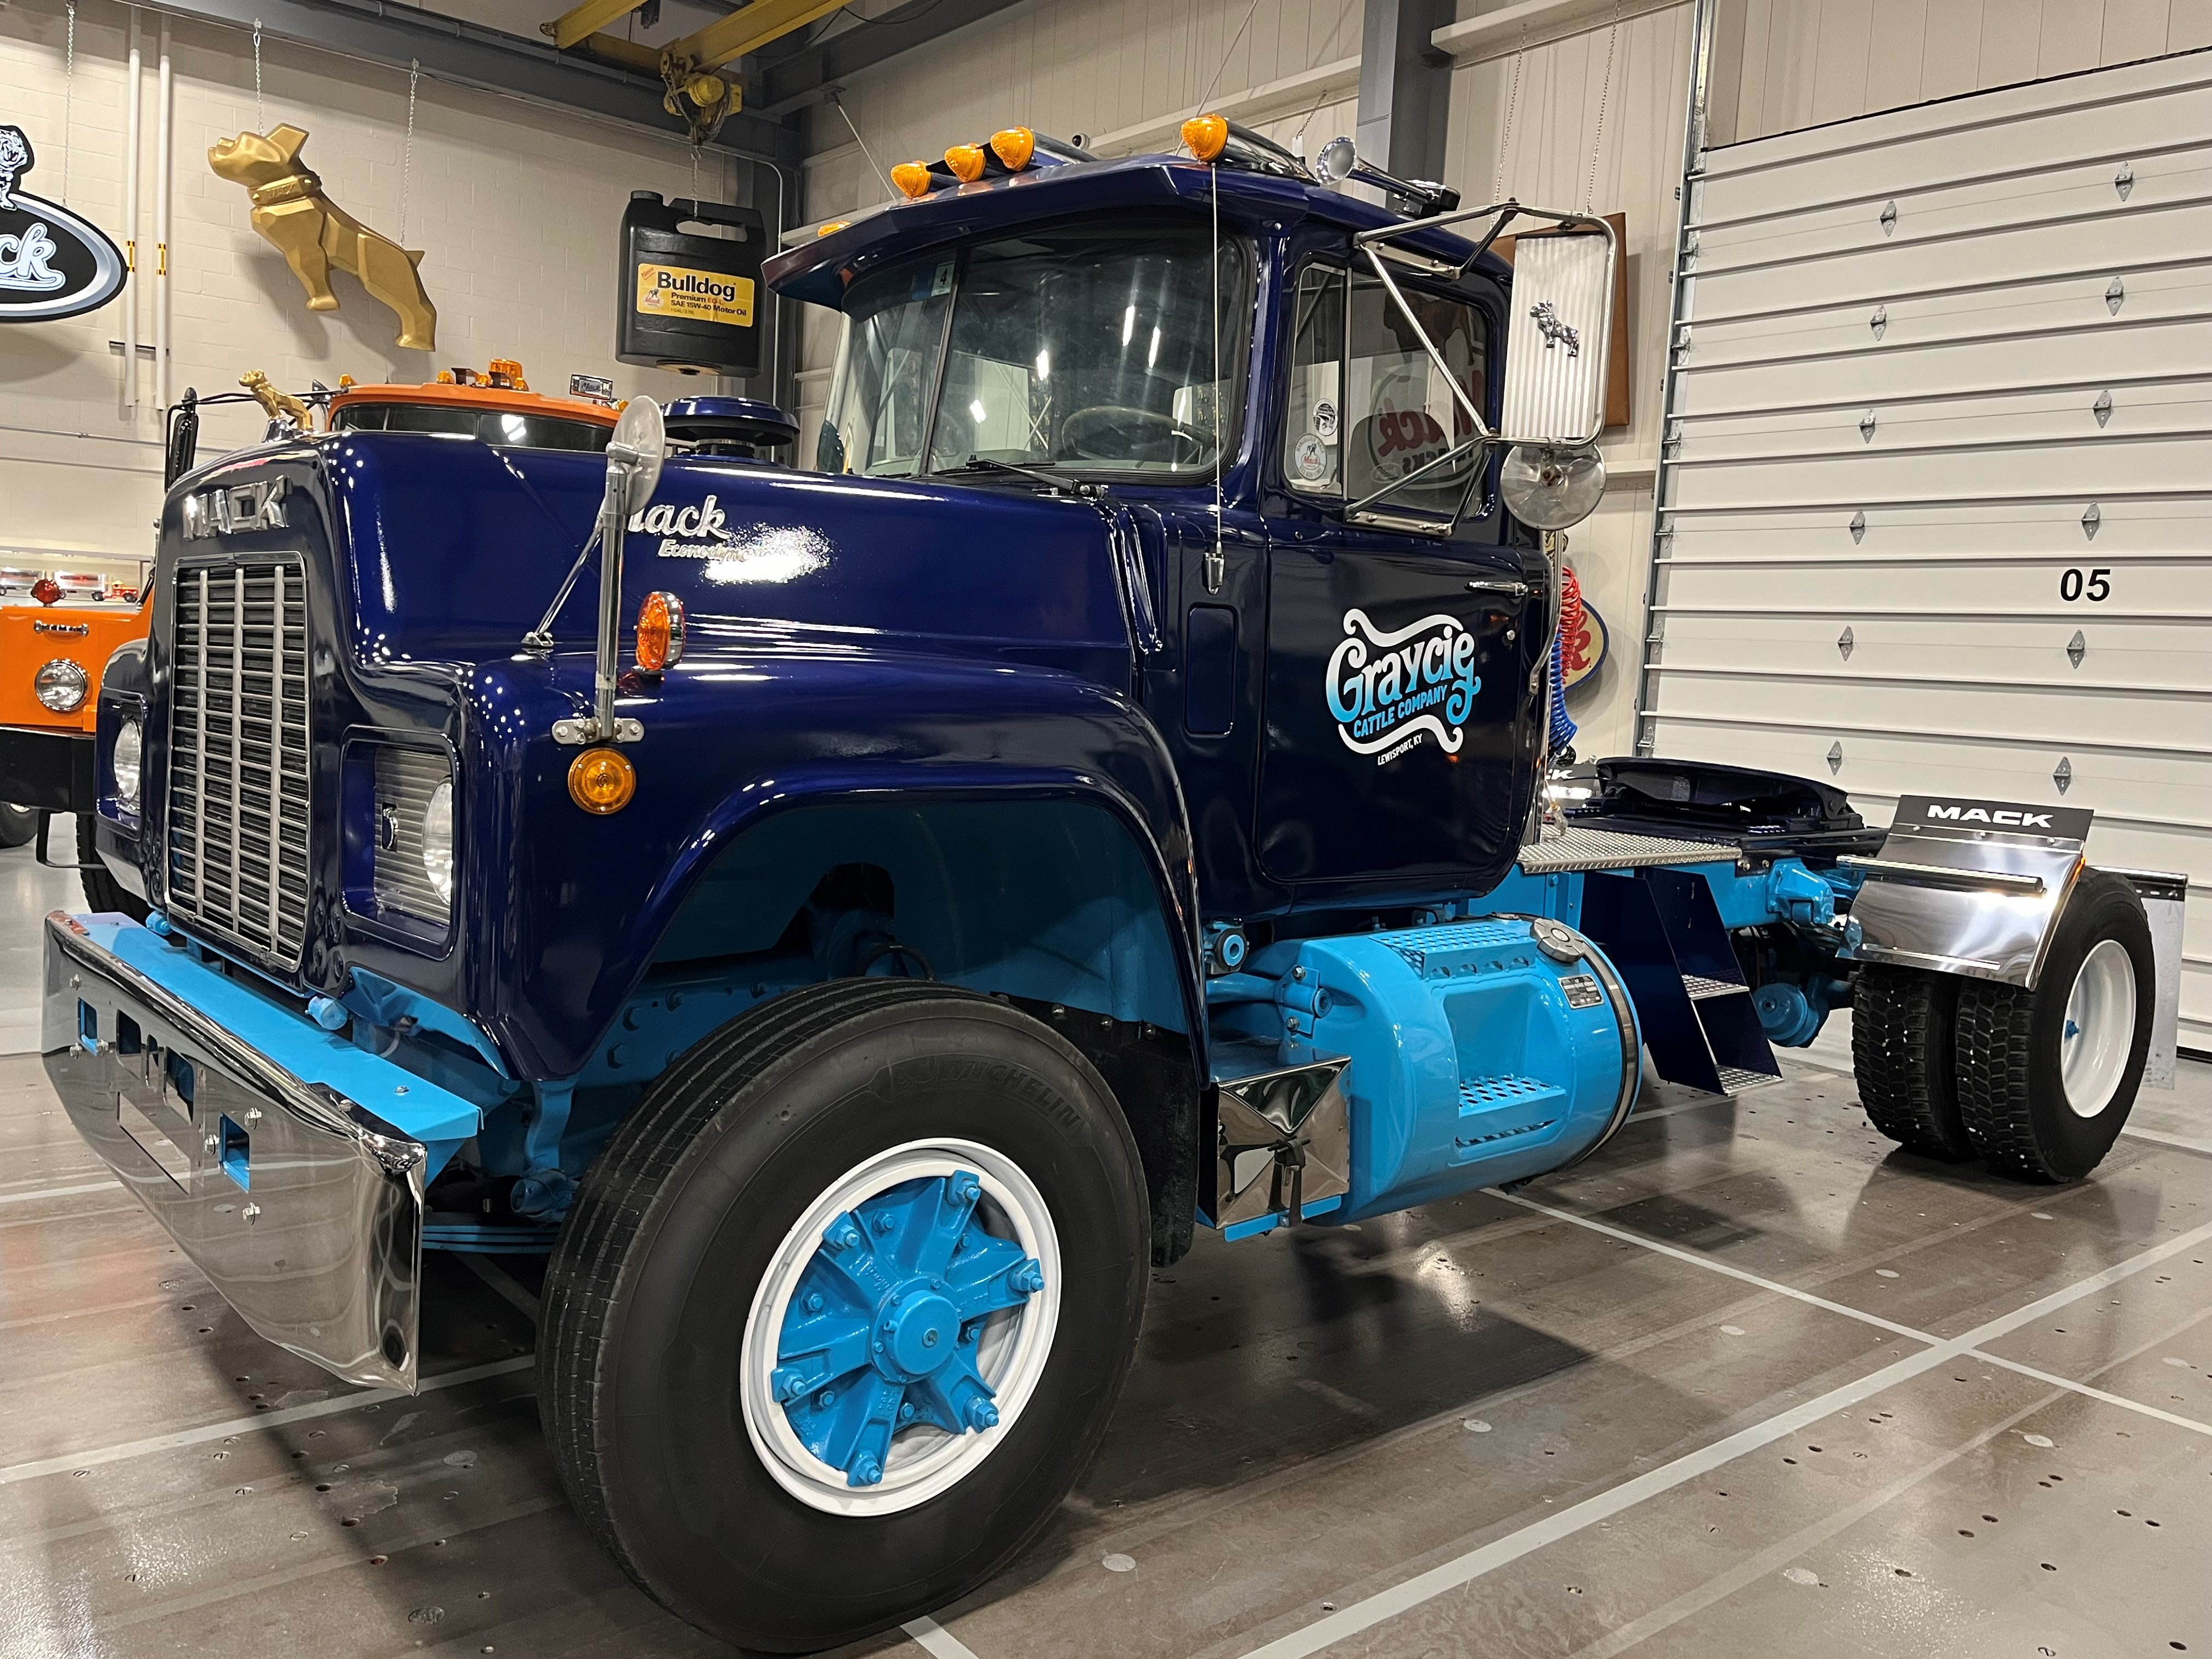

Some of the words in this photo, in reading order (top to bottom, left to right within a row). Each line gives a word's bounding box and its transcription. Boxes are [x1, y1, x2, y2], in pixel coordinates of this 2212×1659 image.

[658, 271, 734, 302] Bulldog
[940, 269, 948, 285] 4
[671, 292, 706, 302] Premium
[687, 302, 712, 311] 15W-40
[713, 304, 735, 315] Motor
[582, 382, 601, 391] Mack
[183, 475, 292, 542] MACK
[2061, 569, 2111, 601] 05
[1326, 626, 1481, 725] Graycie
[1353, 707, 1395, 737] CATTLE
[1398, 685, 1447, 719] COMPANY
[1378, 738, 1413, 765] LEWISPORT,
[1413, 733, 1422, 745] KY
[1927, 805, 2053, 828] MACK
[941, 1059, 1081, 1129] MICHELIN
